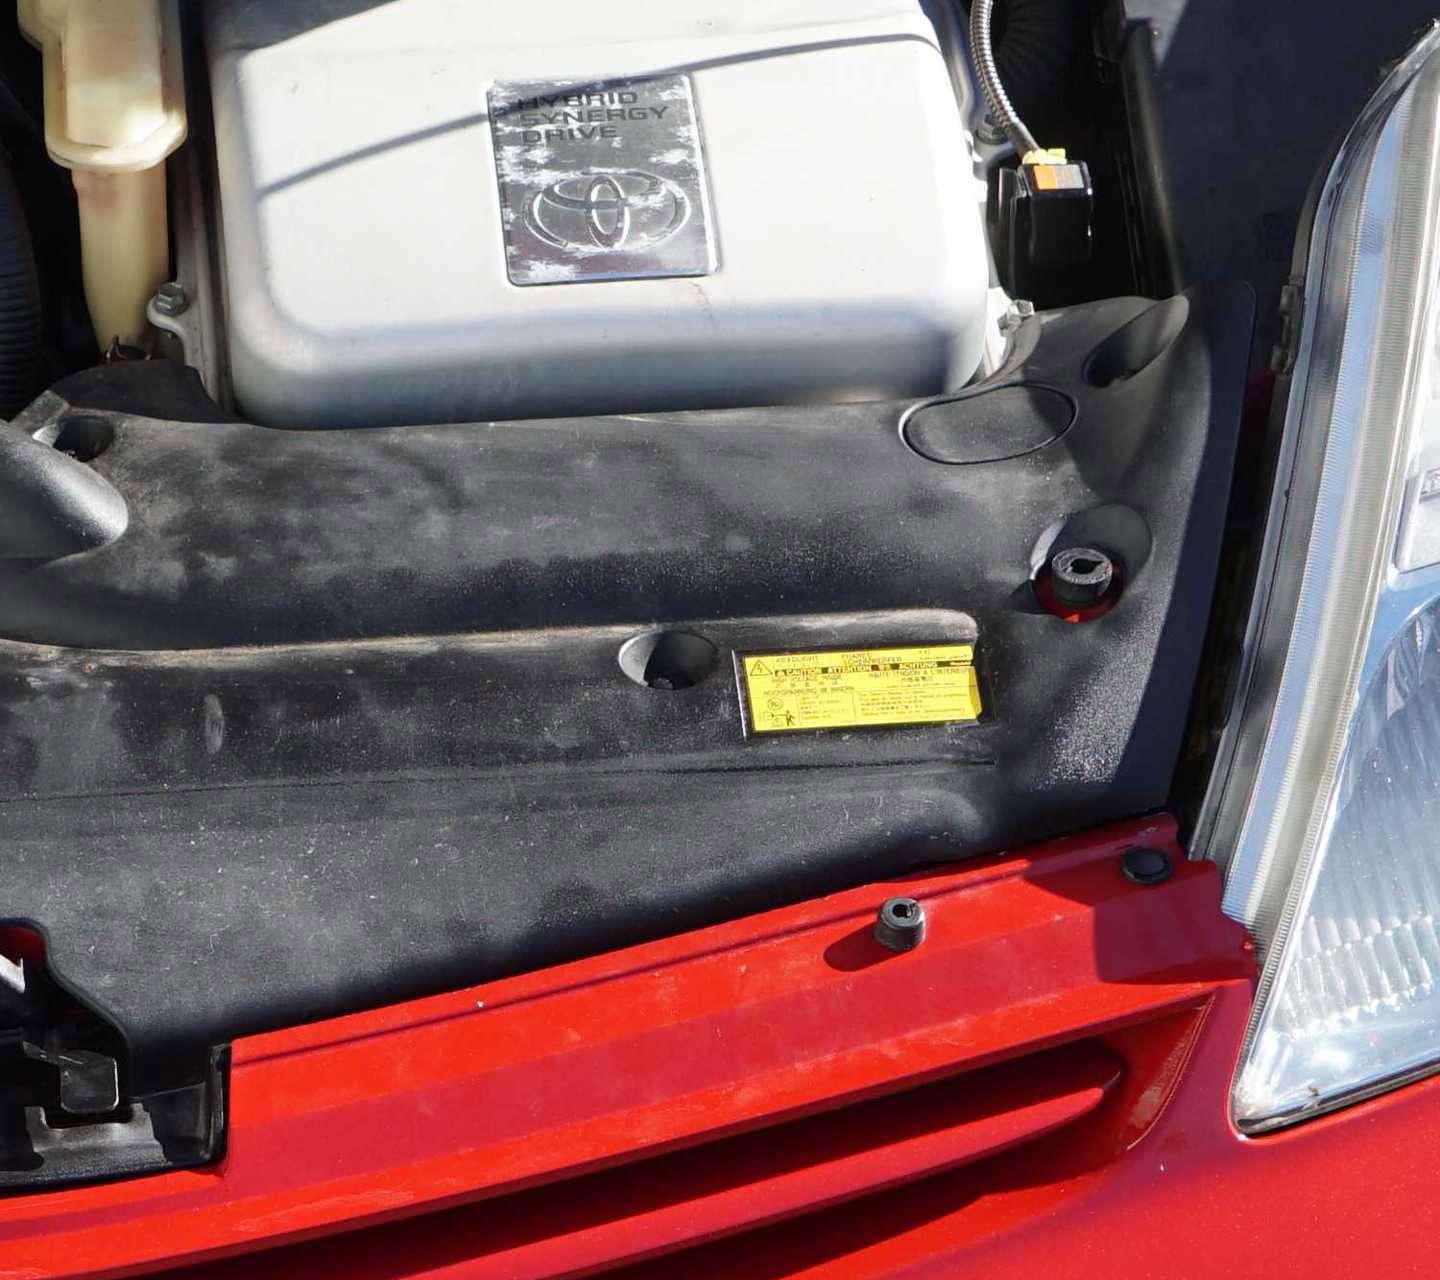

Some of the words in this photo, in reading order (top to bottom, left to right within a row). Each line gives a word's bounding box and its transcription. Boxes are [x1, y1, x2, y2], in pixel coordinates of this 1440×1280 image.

[518, 91, 638, 112] HYBRID
[520, 106, 669, 127] SYNERGY
[522, 125, 618, 144] DRIVE
